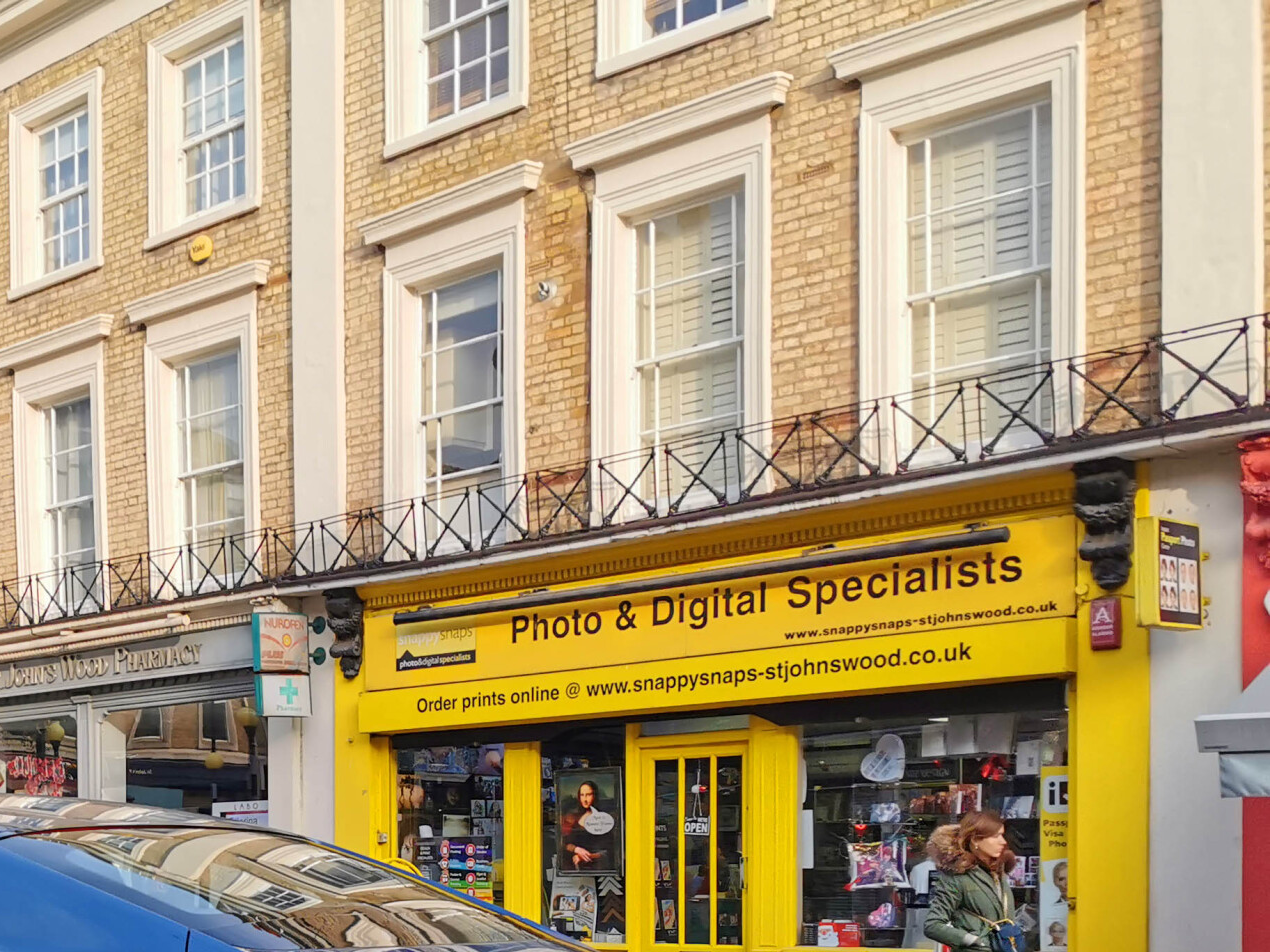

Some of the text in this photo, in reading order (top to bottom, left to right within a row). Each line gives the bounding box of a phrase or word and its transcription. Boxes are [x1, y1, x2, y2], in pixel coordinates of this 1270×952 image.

[511, 552, 1023, 644] Photo & Digital Specialists
[264, 617, 305, 631] NUROFEN
[785, 601, 1058, 640] www.snappysnaps-stjohnswood.co.uk
[398, 627, 473, 647] snappysnaps
[5, 663, 57, 691] JOHN'S
[60, 655, 109, 682] WOOD
[114, 644, 203, 675] PHARMACY
[399, 653, 471, 670] photo&digital specialists
[416, 642, 972, 713] Order prints online @ www.snappysnaps-stjohnswood.co.uk
[685, 822, 708, 833] OPEN
